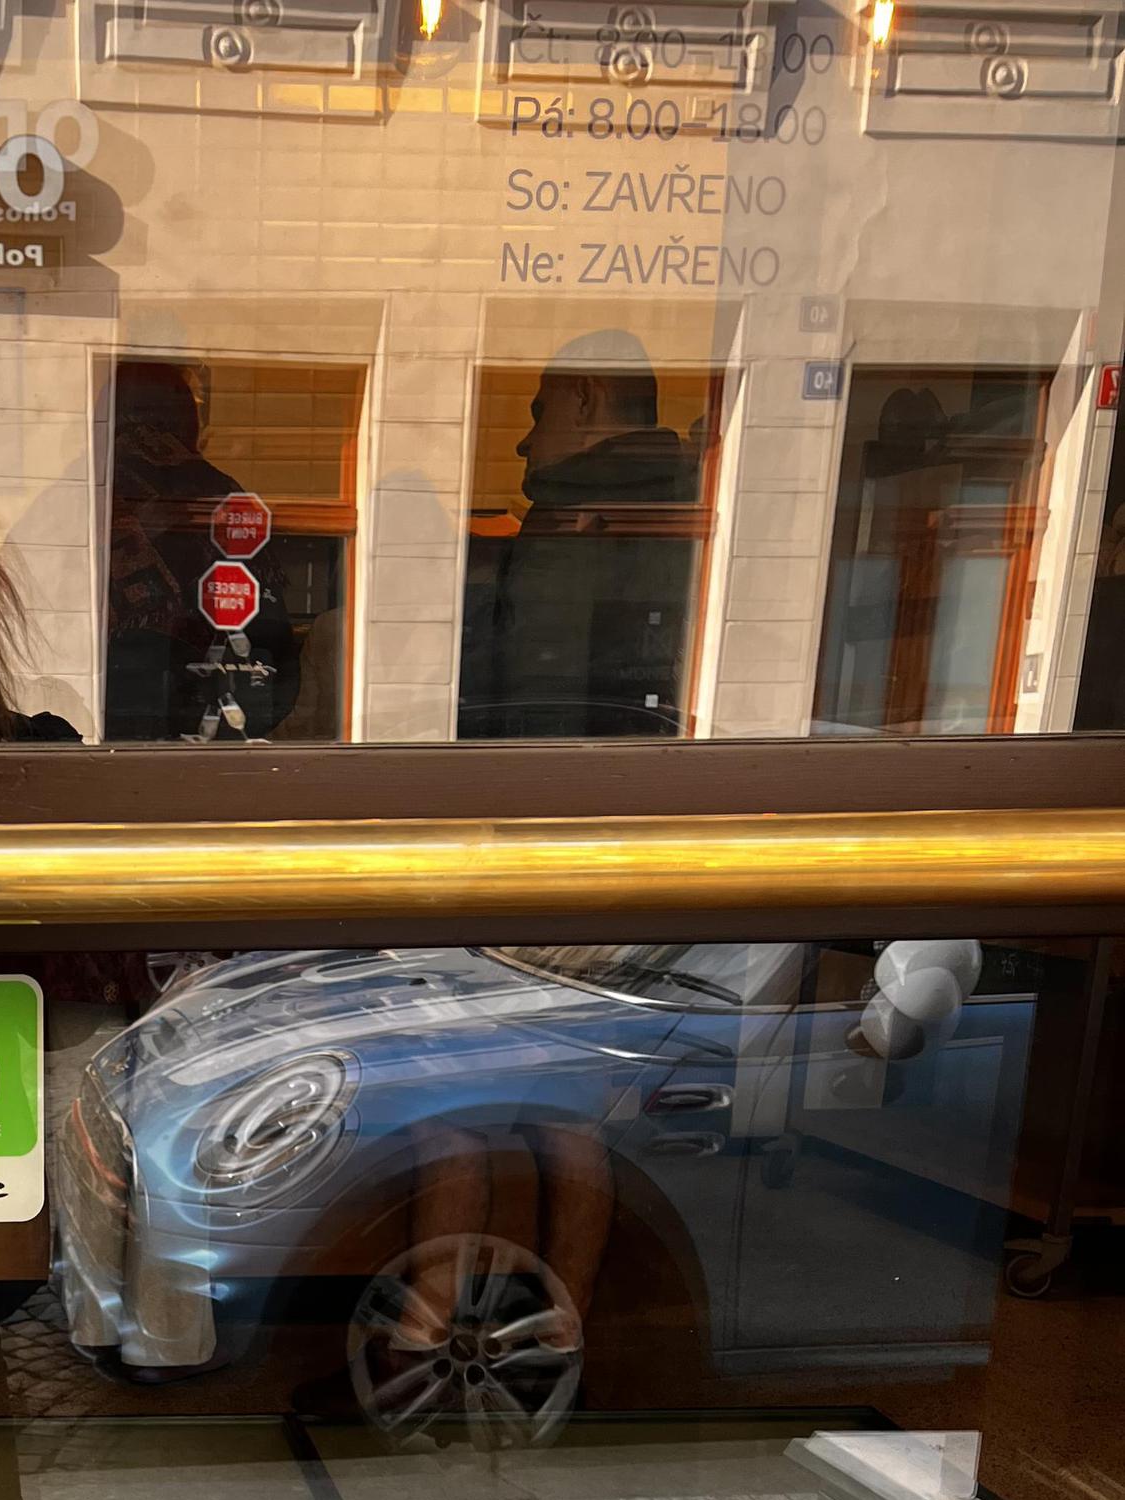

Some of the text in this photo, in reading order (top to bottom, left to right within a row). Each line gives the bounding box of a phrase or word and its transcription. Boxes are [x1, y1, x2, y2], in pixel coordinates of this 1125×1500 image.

[510, 96, 574, 138] Pá:
[506, 163, 787, 216] So: ZAVŘENO
[500, 234, 781, 287] Ne: ZAVŘENO
